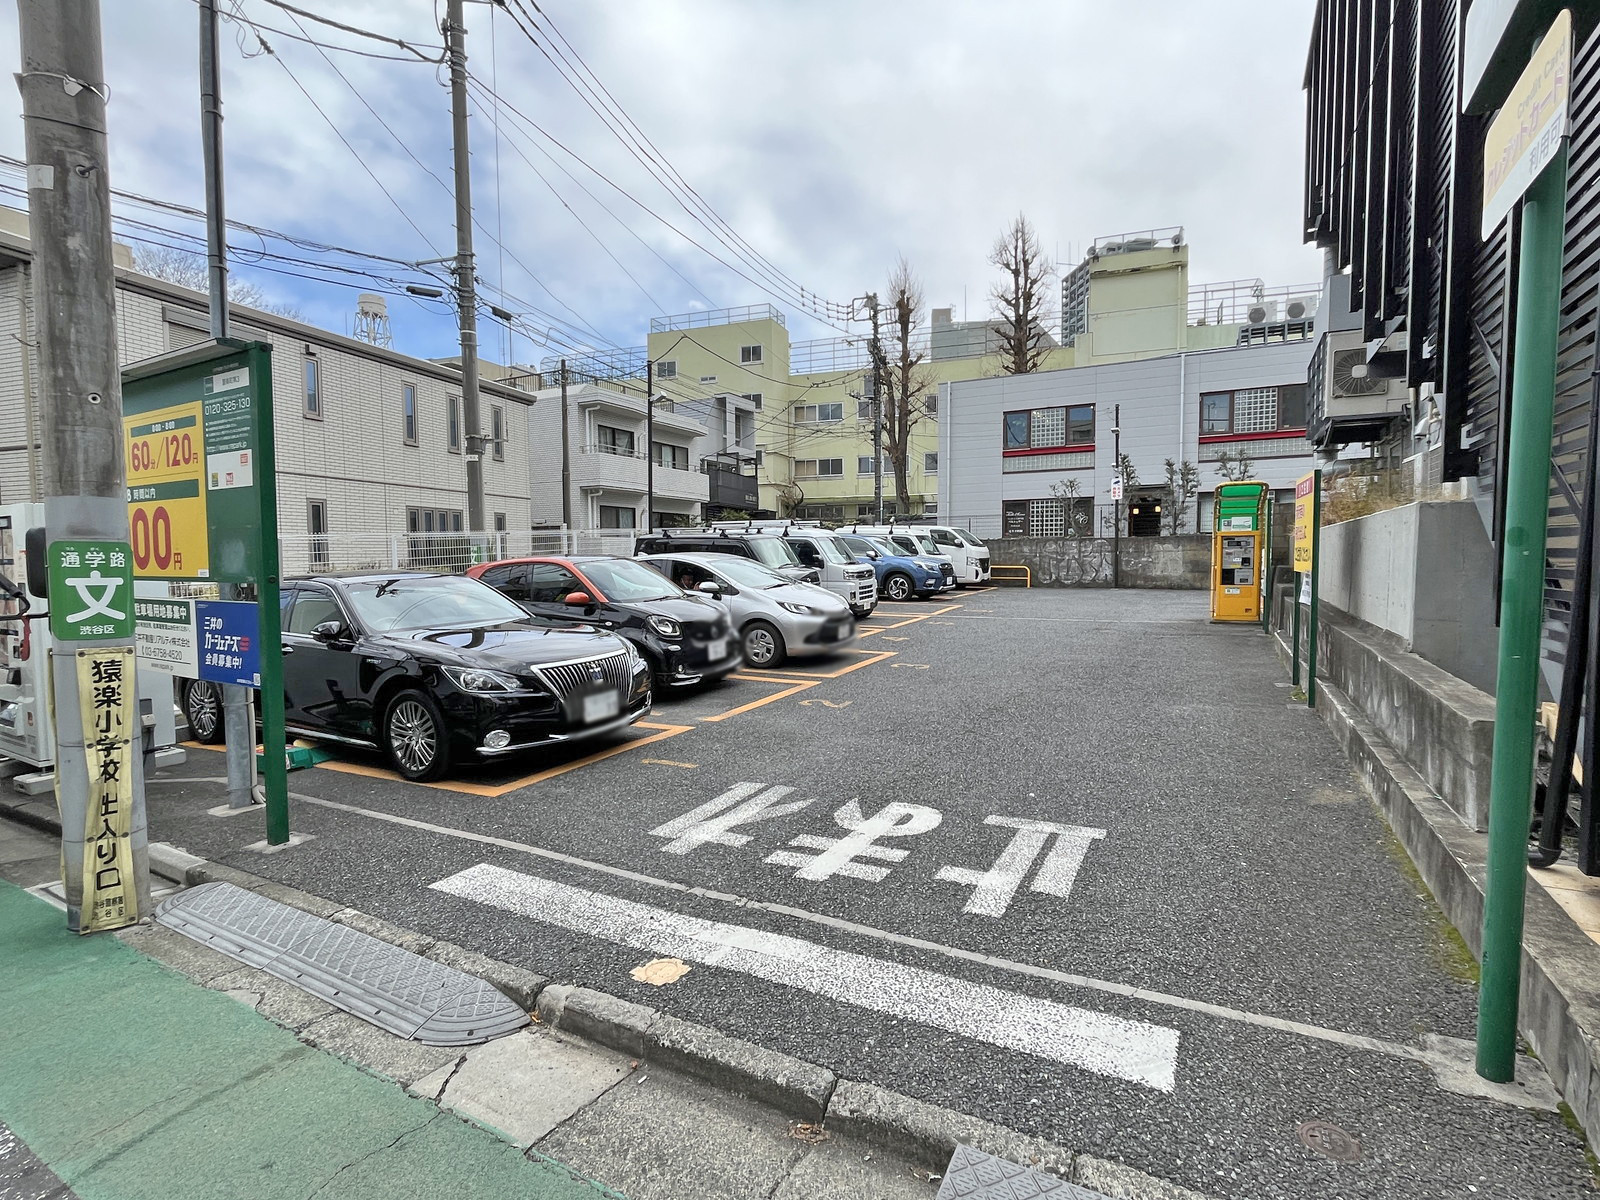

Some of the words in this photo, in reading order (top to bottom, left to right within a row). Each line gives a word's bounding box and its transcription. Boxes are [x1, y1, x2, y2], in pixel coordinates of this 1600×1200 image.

[1543, 36, 1566, 80] Card
[1486, 66, 1565, 196] クレジットカード
[1528, 112, 1563, 176] 利用可
[205, 397, 251, 416] 0120-325-130
[133, 487, 156, 500] 時間以内
[61, 551, 125, 567] 通学路
[65, 570, 126, 623] 文
[80, 624, 115, 635] 渋谷区
[204, 616, 223, 630] 三井の
[91, 659, 123, 783] 猿楽小学校
[96, 792, 122, 891] 出入り口
